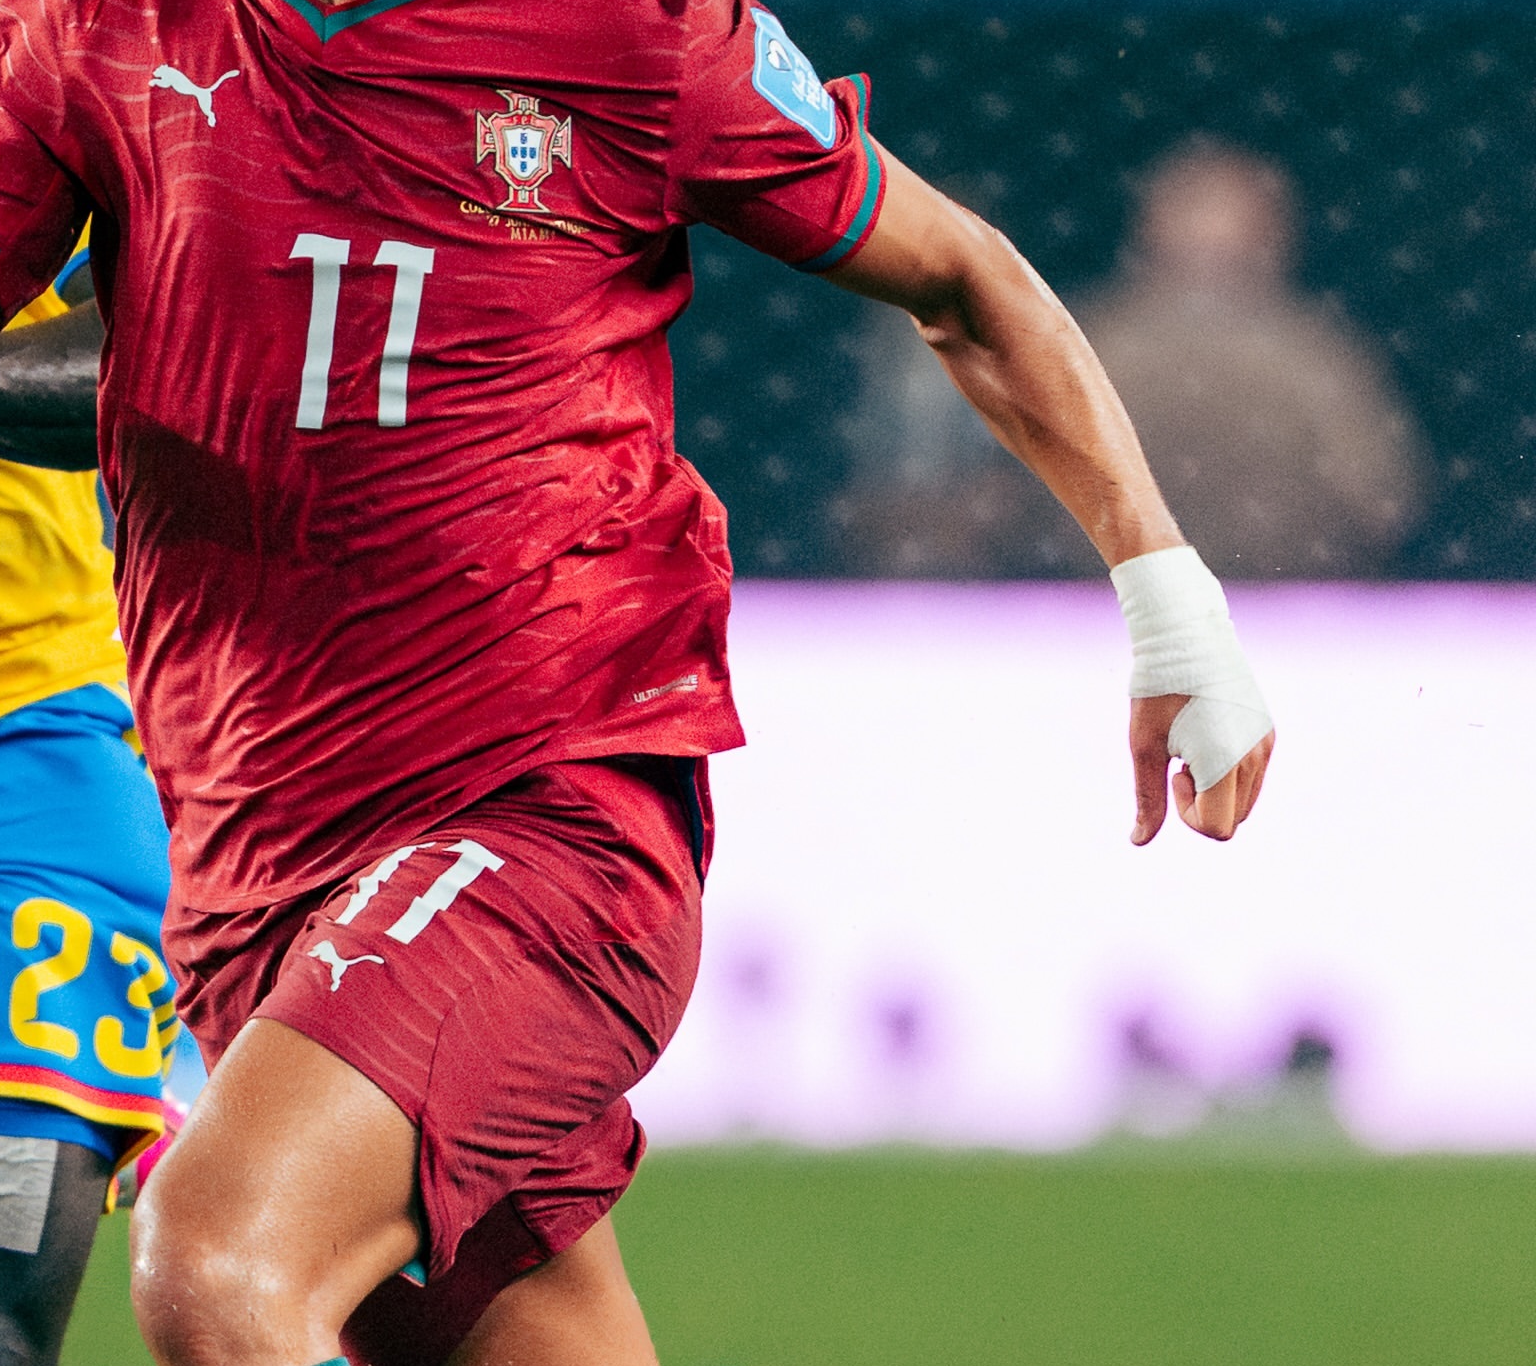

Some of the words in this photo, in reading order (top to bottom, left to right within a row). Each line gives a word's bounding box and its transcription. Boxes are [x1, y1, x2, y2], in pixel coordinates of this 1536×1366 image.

[288, 232, 436, 430] 11
[326, 838, 506, 945] 11
[8, 896, 168, 1079] 23
